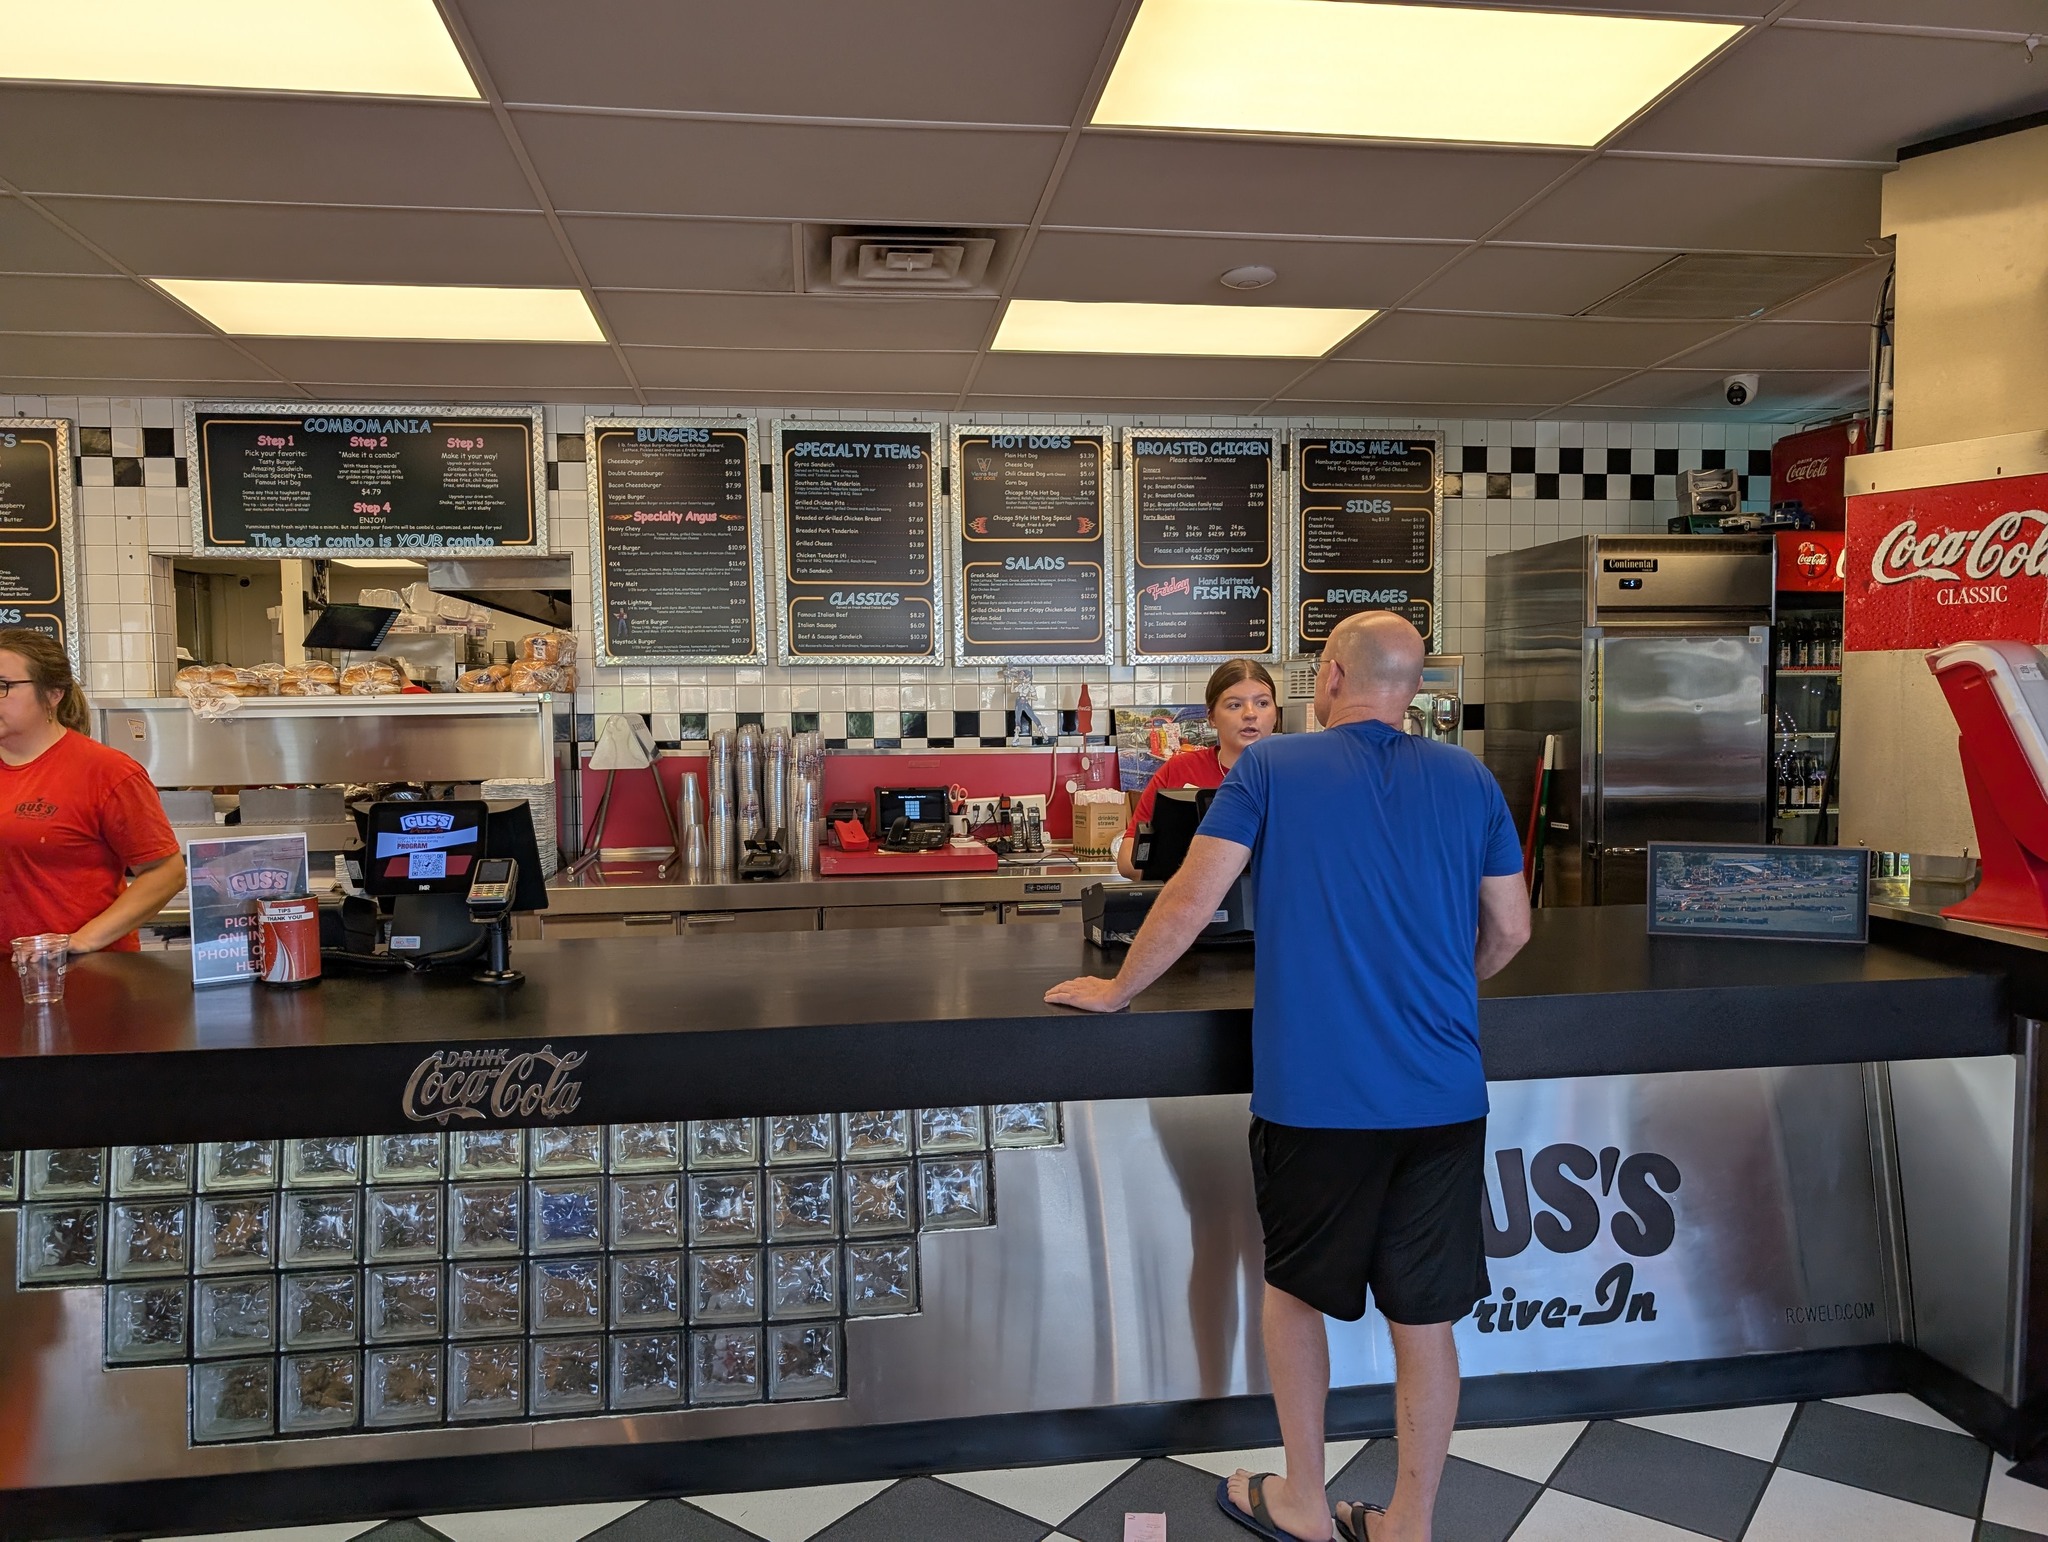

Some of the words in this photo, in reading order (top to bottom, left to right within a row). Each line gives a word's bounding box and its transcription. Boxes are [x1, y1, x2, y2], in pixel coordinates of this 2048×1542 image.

[304, 418, 431, 433] COMBOMANIA
[637, 428, 709, 442] BURGERS
[992, 435, 1025, 448] HOT
[1029, 435, 1071, 449] DOGS
[257, 436, 286, 449] Step
[288, 436, 294, 446] 1
[350, 436, 377, 450] Step
[380, 436, 388, 447] 2
[447, 438, 473, 451] Step
[476, 438, 484, 448] 3
[1137, 441, 1207, 455] BROASTED
[1210, 441, 1269, 456] CHICKEN
[1329, 440, 1365, 454] KIDS
[1369, 441, 1408, 455] MEAL
[794, 442, 870, 458] SPECIALTY
[874, 444, 920, 459] ITEMS
[1786, 457, 1830, 483] Coca-Cola
[362, 488, 381, 496] $4.79
[353, 502, 380, 515] Step
[382, 502, 391, 513] 4
[1346, 500, 1391, 513] SIDES
[633, 511, 683, 524] Specialty
[685, 511, 717, 524] Angus
[250, 533, 282, 547] The
[286, 533, 321, 547] best
[326, 534, 374, 547] combo
[379, 534, 391, 547] is
[397, 534, 443, 547] YOUR
[447, 534, 494, 547] combo
[1005, 556, 1065, 570] SALADS
[1609, 559, 1654, 568] Continental
[1797, 553, 1828, 565] Coca-Cola
[1220, 576, 1253, 585] Battered
[1146, 576, 1190, 600] Friday
[1193, 586, 1230, 600] FISH
[1234, 586, 1260, 599] FRY
[829, 592, 900, 606] CLASSICS
[1327, 589, 1408, 603] BEVERAGES
[1937, 585, 2008, 606] CLASSIC
[405, 815, 449, 827] GUS'S
[1098, 815, 1119, 823] drinking
[231, 871, 288, 892] GUS'S
[218, 931, 261, 944] ONLIN
[198, 947, 248, 960] PHONE
[236, 960, 263, 972] HER
[446, 1049, 509, 1068] DRINK
[402, 1050, 588, 1121] Coca-Cola
[1485, 1143, 1681, 1258] US'S
[1472, 1262, 1658, 1333] rive-In
[1786, 1302, 1875, 1324] RCWELD.COM
